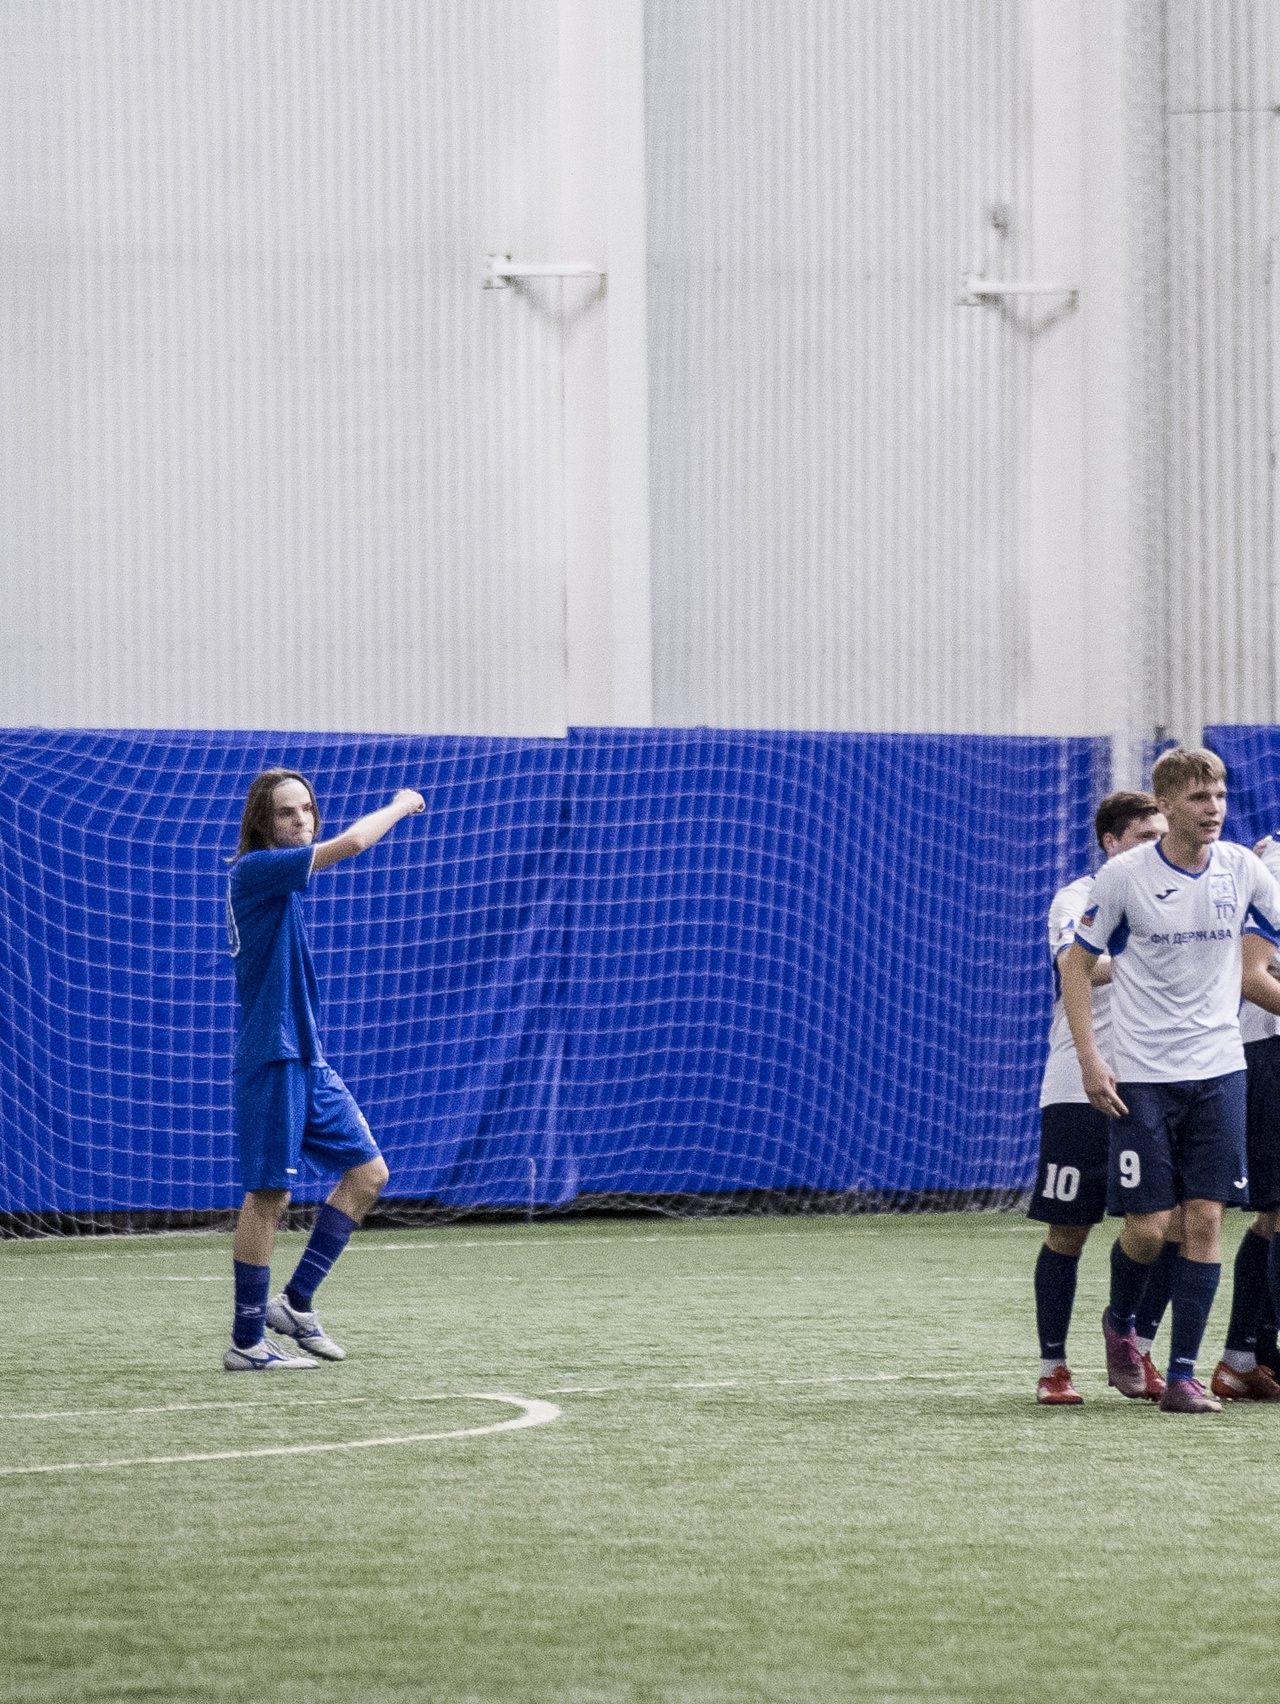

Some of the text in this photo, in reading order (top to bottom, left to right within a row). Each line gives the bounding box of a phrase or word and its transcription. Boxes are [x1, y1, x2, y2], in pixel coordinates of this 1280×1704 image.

[1151, 929, 1232, 944] ФК ДЕРЖАВА
[1042, 1162, 1081, 1202] 10
[1119, 1150, 1141, 1188] 9
